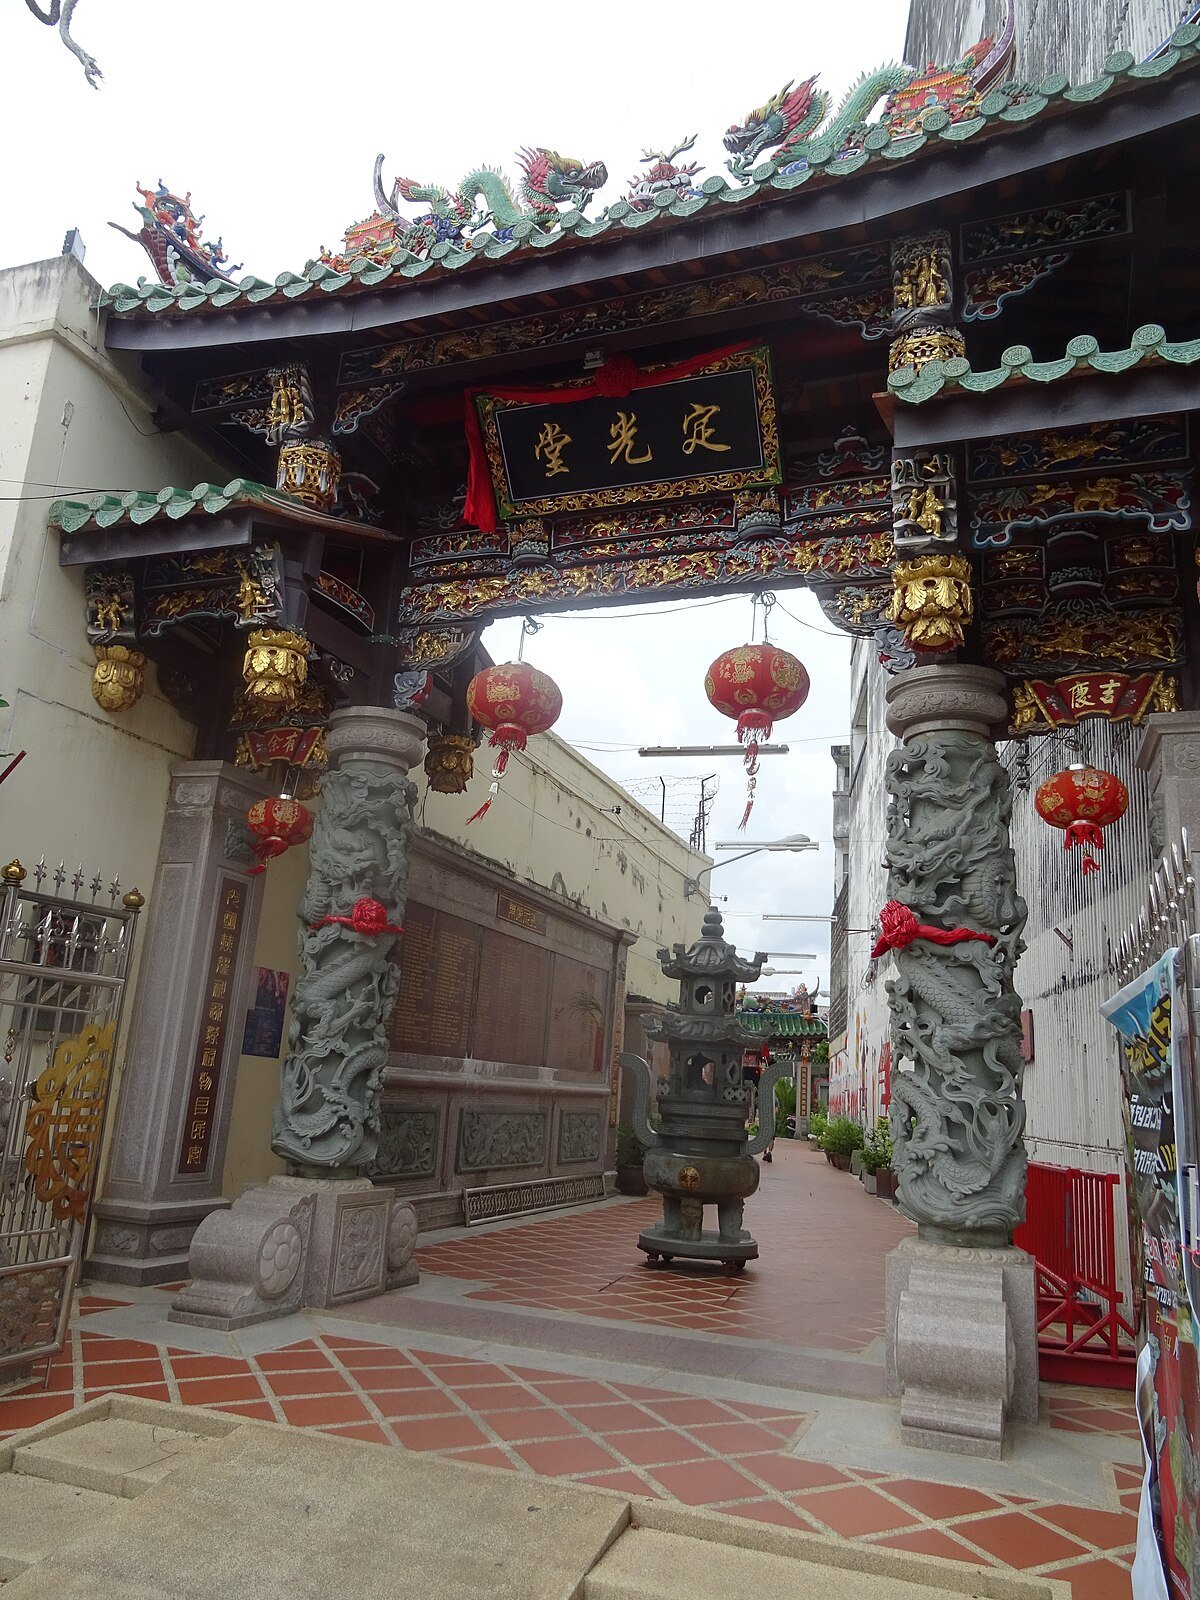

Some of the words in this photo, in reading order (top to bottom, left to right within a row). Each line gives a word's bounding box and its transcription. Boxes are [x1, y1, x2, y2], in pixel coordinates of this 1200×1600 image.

[534, 402, 732, 478] 定光堂
[1067, 678, 1121, 710] 吉慶
